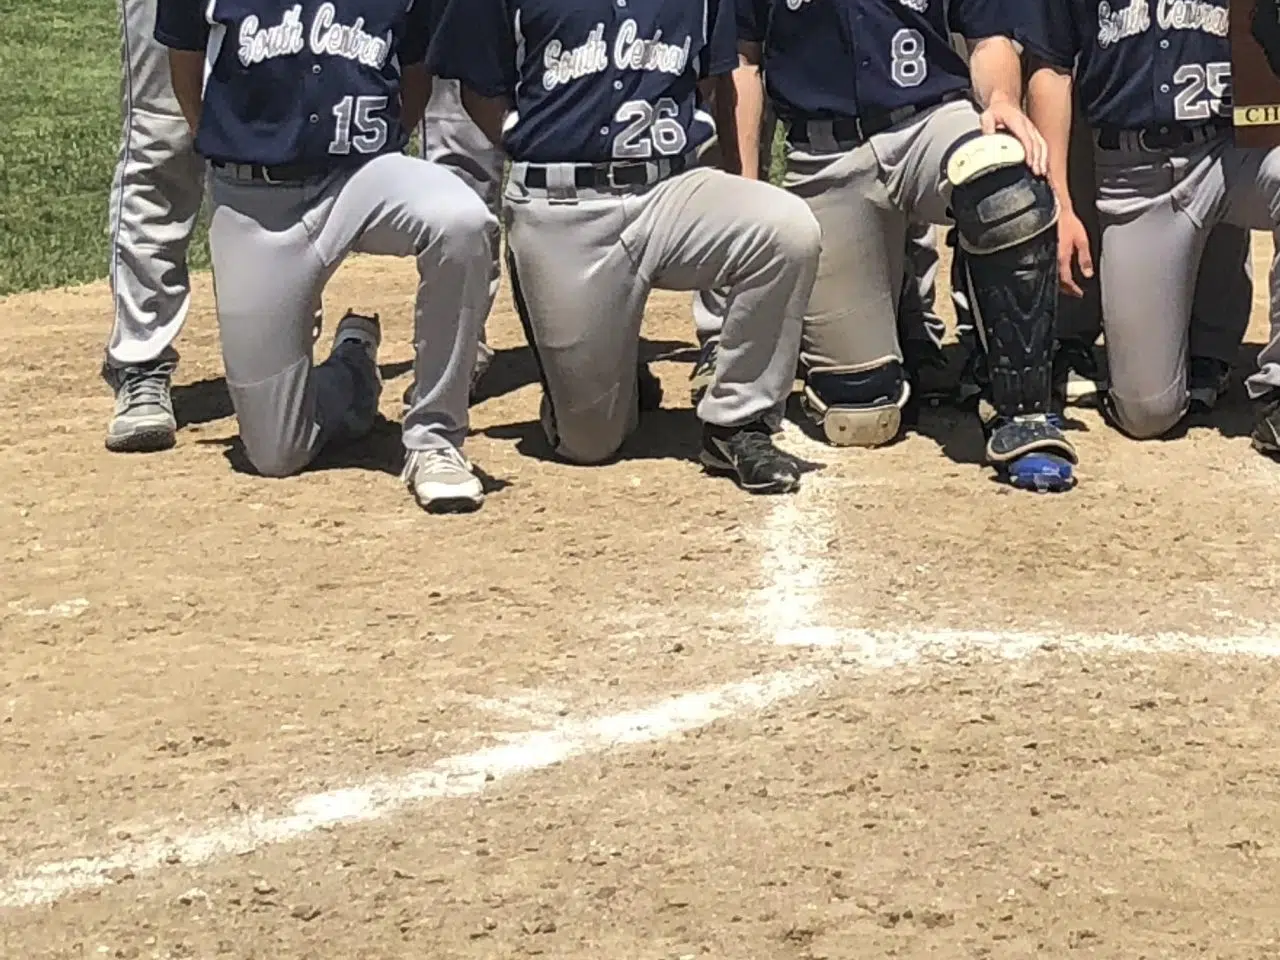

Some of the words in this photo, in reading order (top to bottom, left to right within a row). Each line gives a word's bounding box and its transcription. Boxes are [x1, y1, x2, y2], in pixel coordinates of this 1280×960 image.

[238, 4, 305, 68] South
[310, 2, 393, 70] Central
[543, 22, 608, 92] South
[613, 19, 691, 76] Central
[891, 28, 927, 87] 8
[1173, 62, 1232, 120] 25
[328, 95, 388, 155] 15
[611, 97, 687, 158] 26
